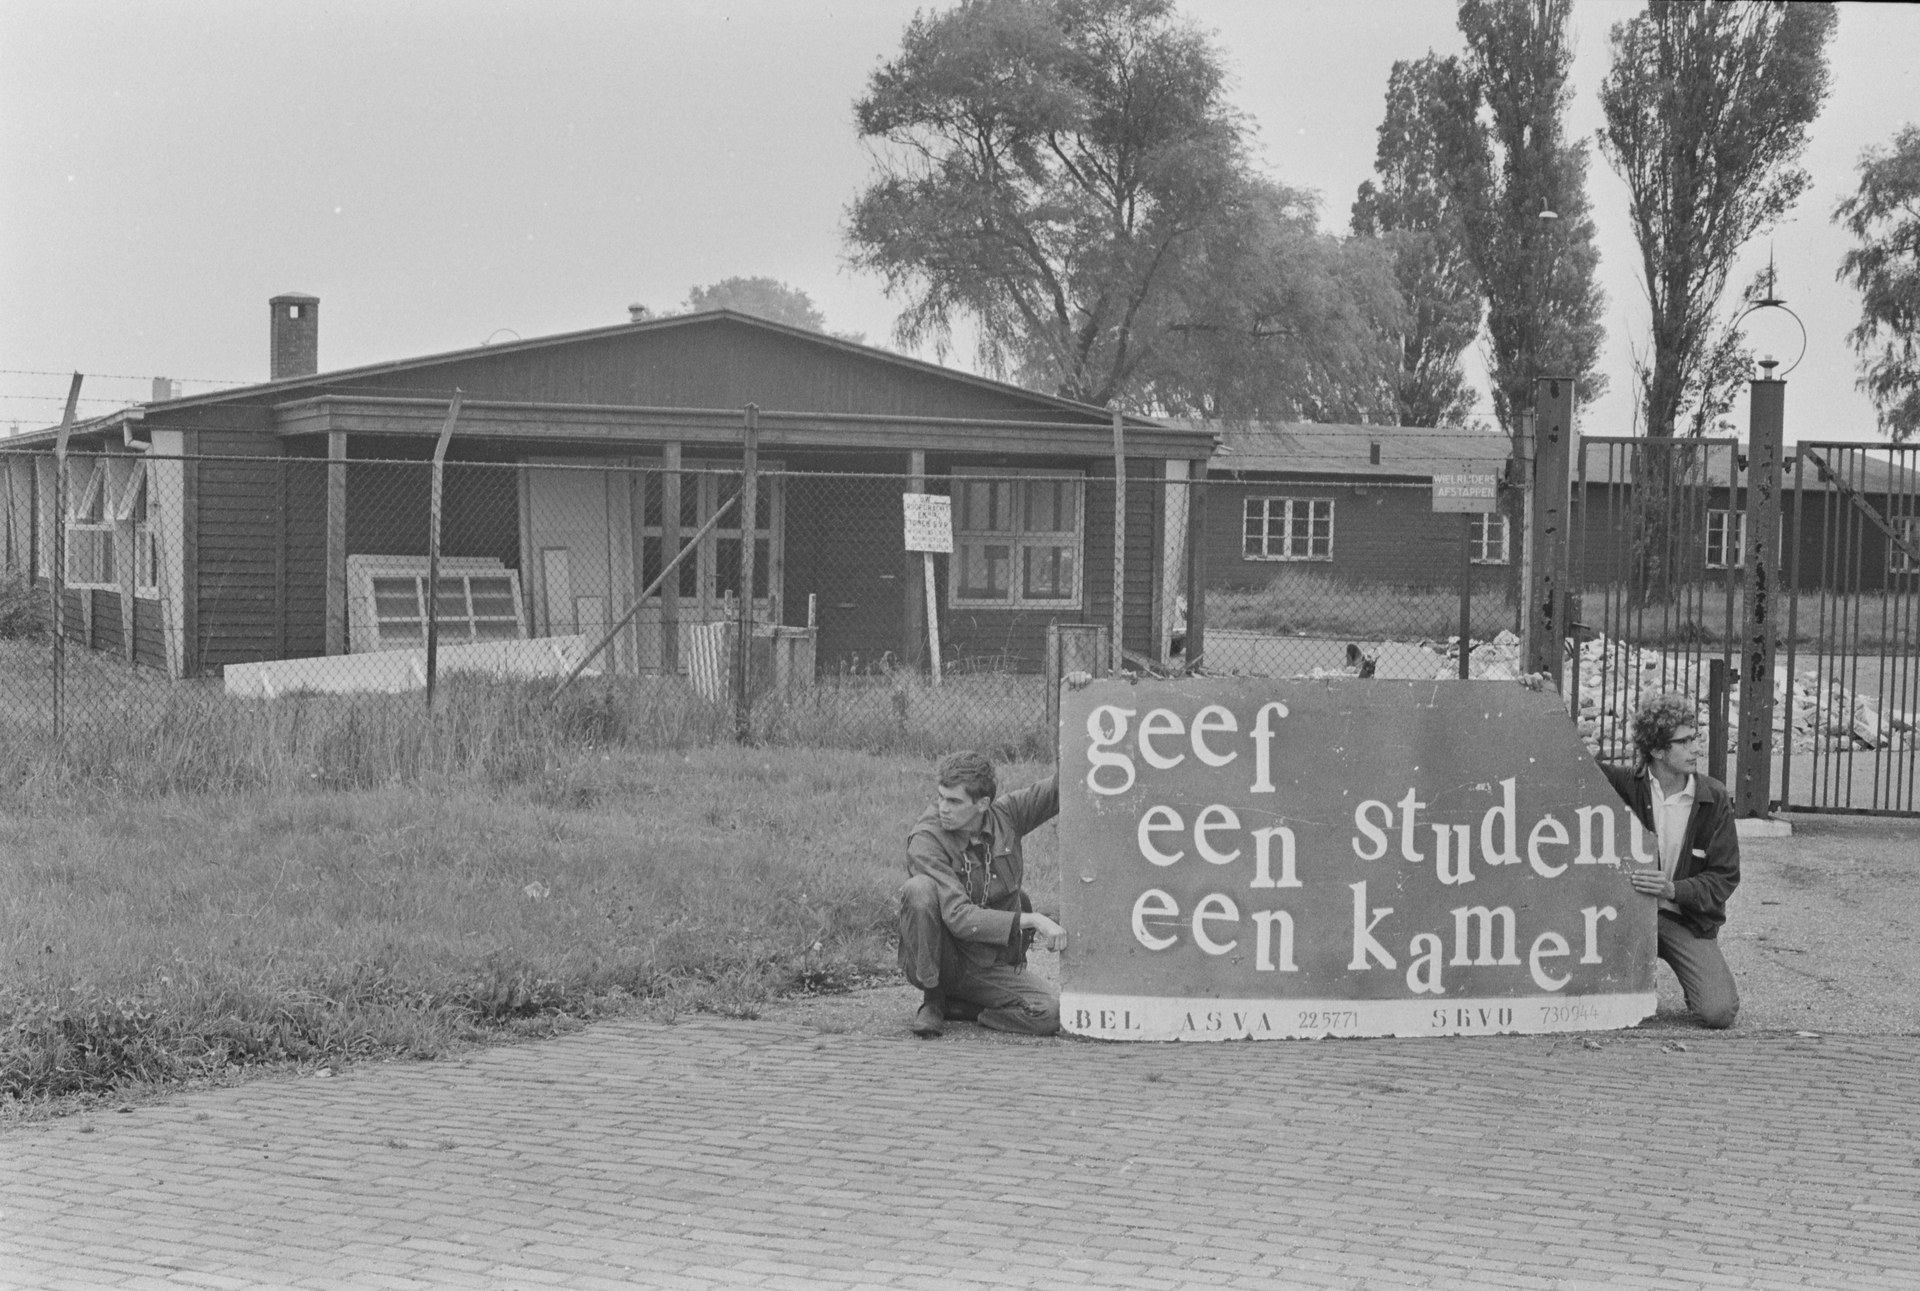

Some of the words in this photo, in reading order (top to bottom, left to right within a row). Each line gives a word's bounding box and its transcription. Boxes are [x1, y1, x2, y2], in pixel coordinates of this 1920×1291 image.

[1437, 487, 1495, 498] AFSTAPPEN
[1086, 701, 1288, 796] geef
[1138, 804, 1302, 888] een
[1352, 778, 1654, 884] student
[1131, 888, 1298, 972] een
[1347, 880, 1617, 994] kamer
[1075, 1009, 1141, 1030] BEL
[1181, 1011, 1272, 1032] ASVA
[1298, 1011, 1359, 1030] 225771
[1431, 1007, 1513, 1028] SRVU
[1540, 1004, 1600, 1024] 730944
